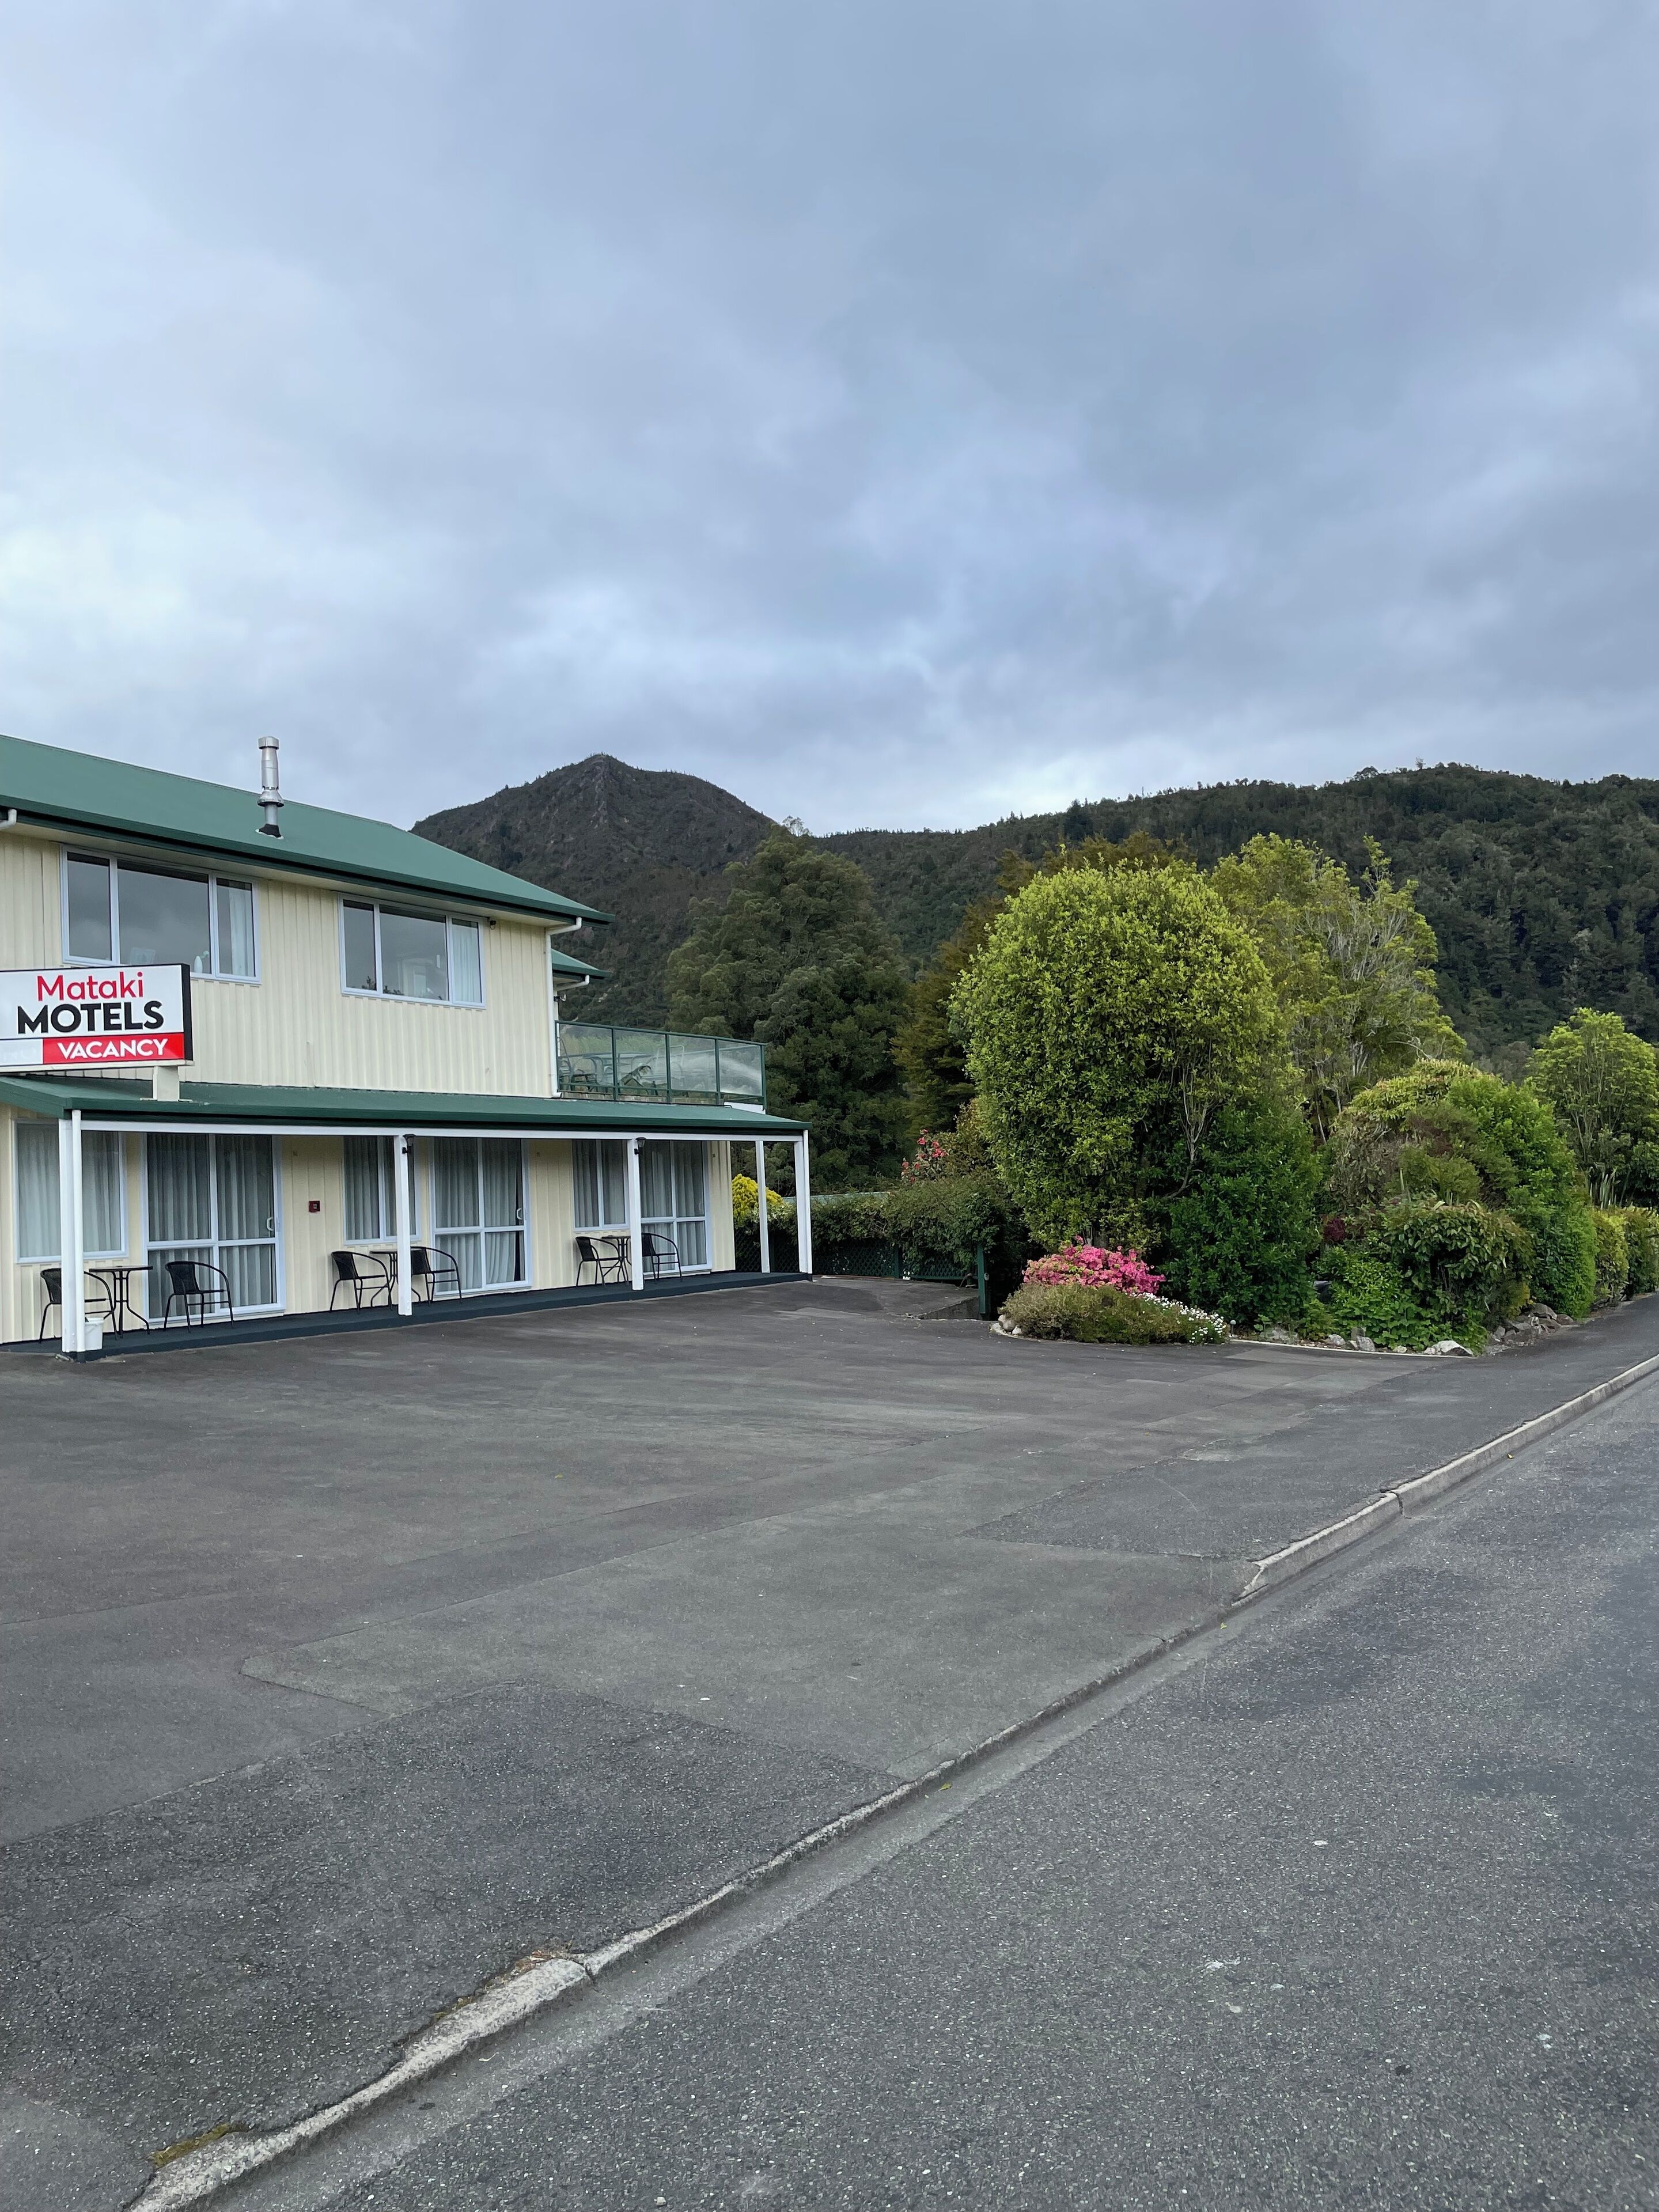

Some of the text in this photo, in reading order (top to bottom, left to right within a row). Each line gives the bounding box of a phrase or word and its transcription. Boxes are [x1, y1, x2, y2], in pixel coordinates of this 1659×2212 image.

[37, 971, 143, 1001] Mataki
[18, 1001, 164, 1034] MOTELS
[58, 1039, 168, 1059] VACANCY
